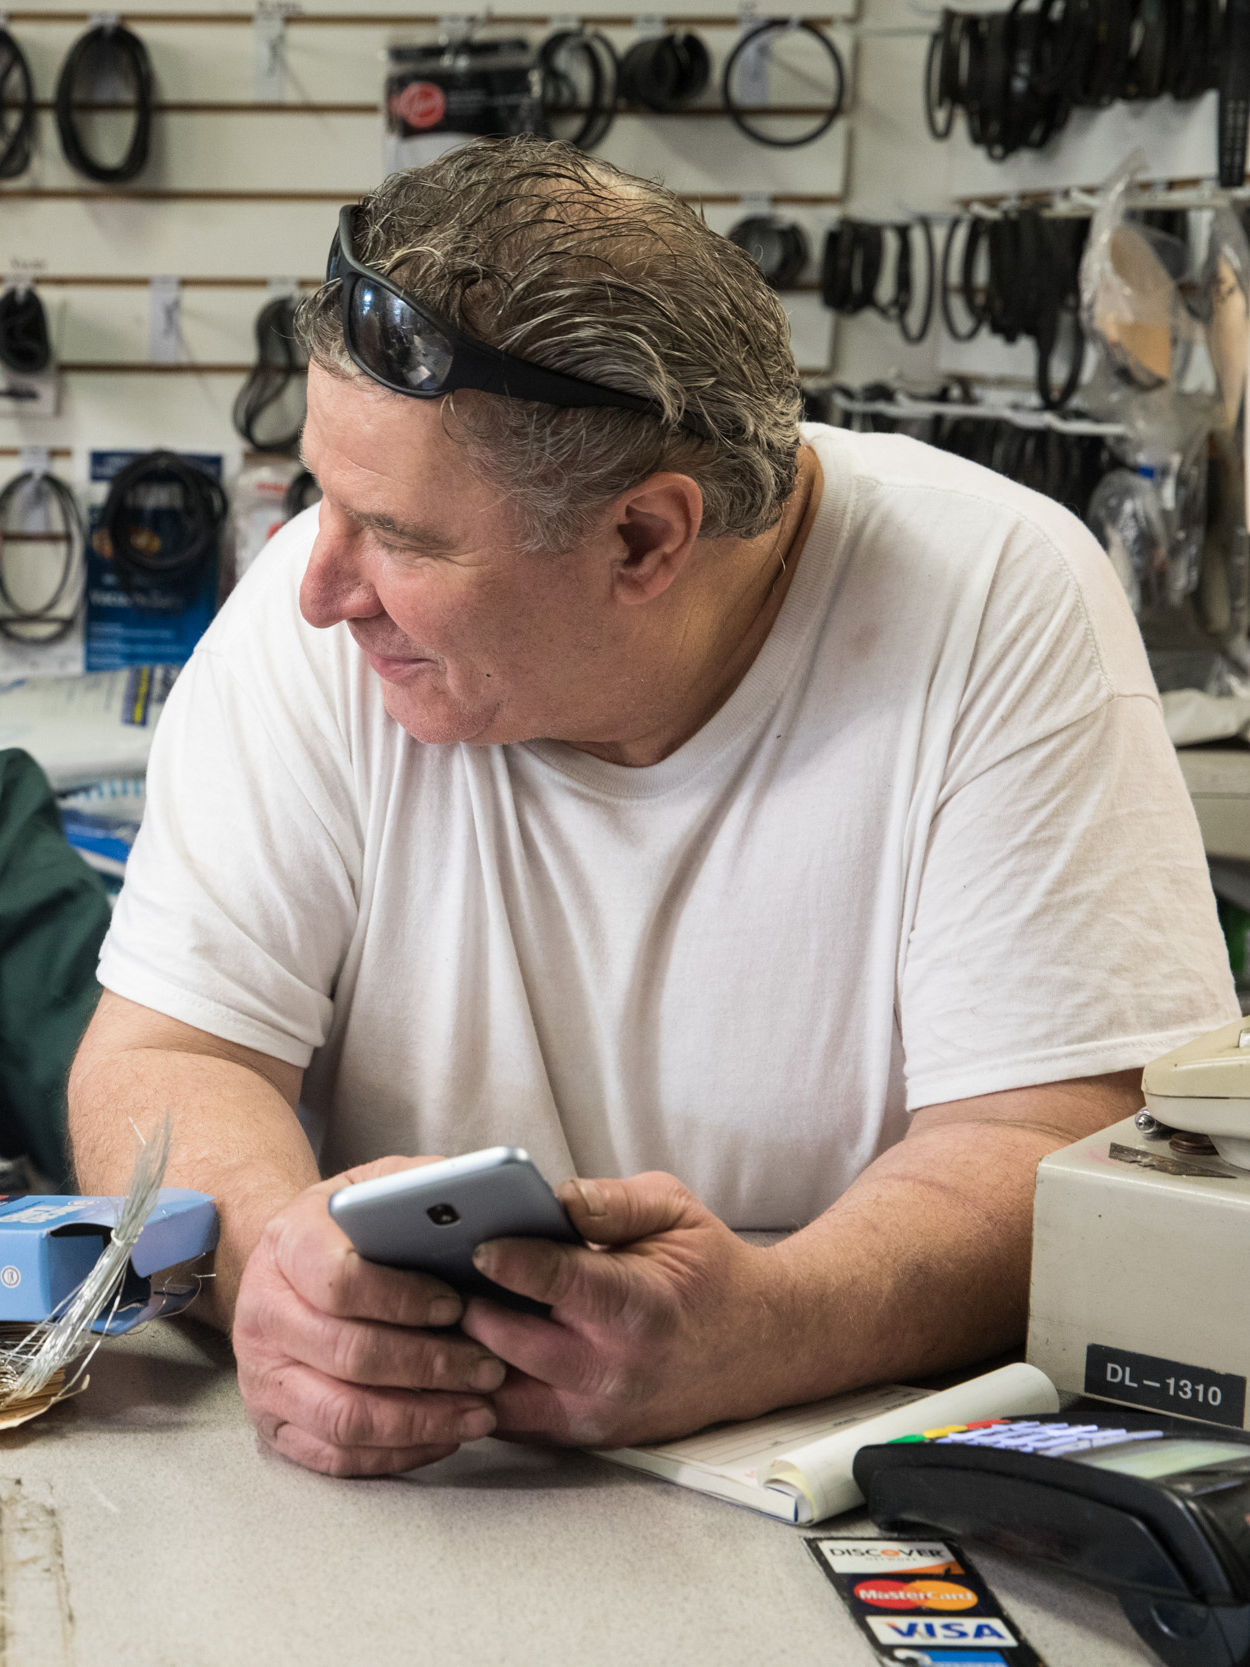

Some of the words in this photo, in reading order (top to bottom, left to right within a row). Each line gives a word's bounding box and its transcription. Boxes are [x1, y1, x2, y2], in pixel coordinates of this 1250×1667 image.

[828, 1548, 945, 1559] DISCOVER
[859, 1588, 974, 1602] MasterCard
[884, 1621, 1007, 1640] VISA
